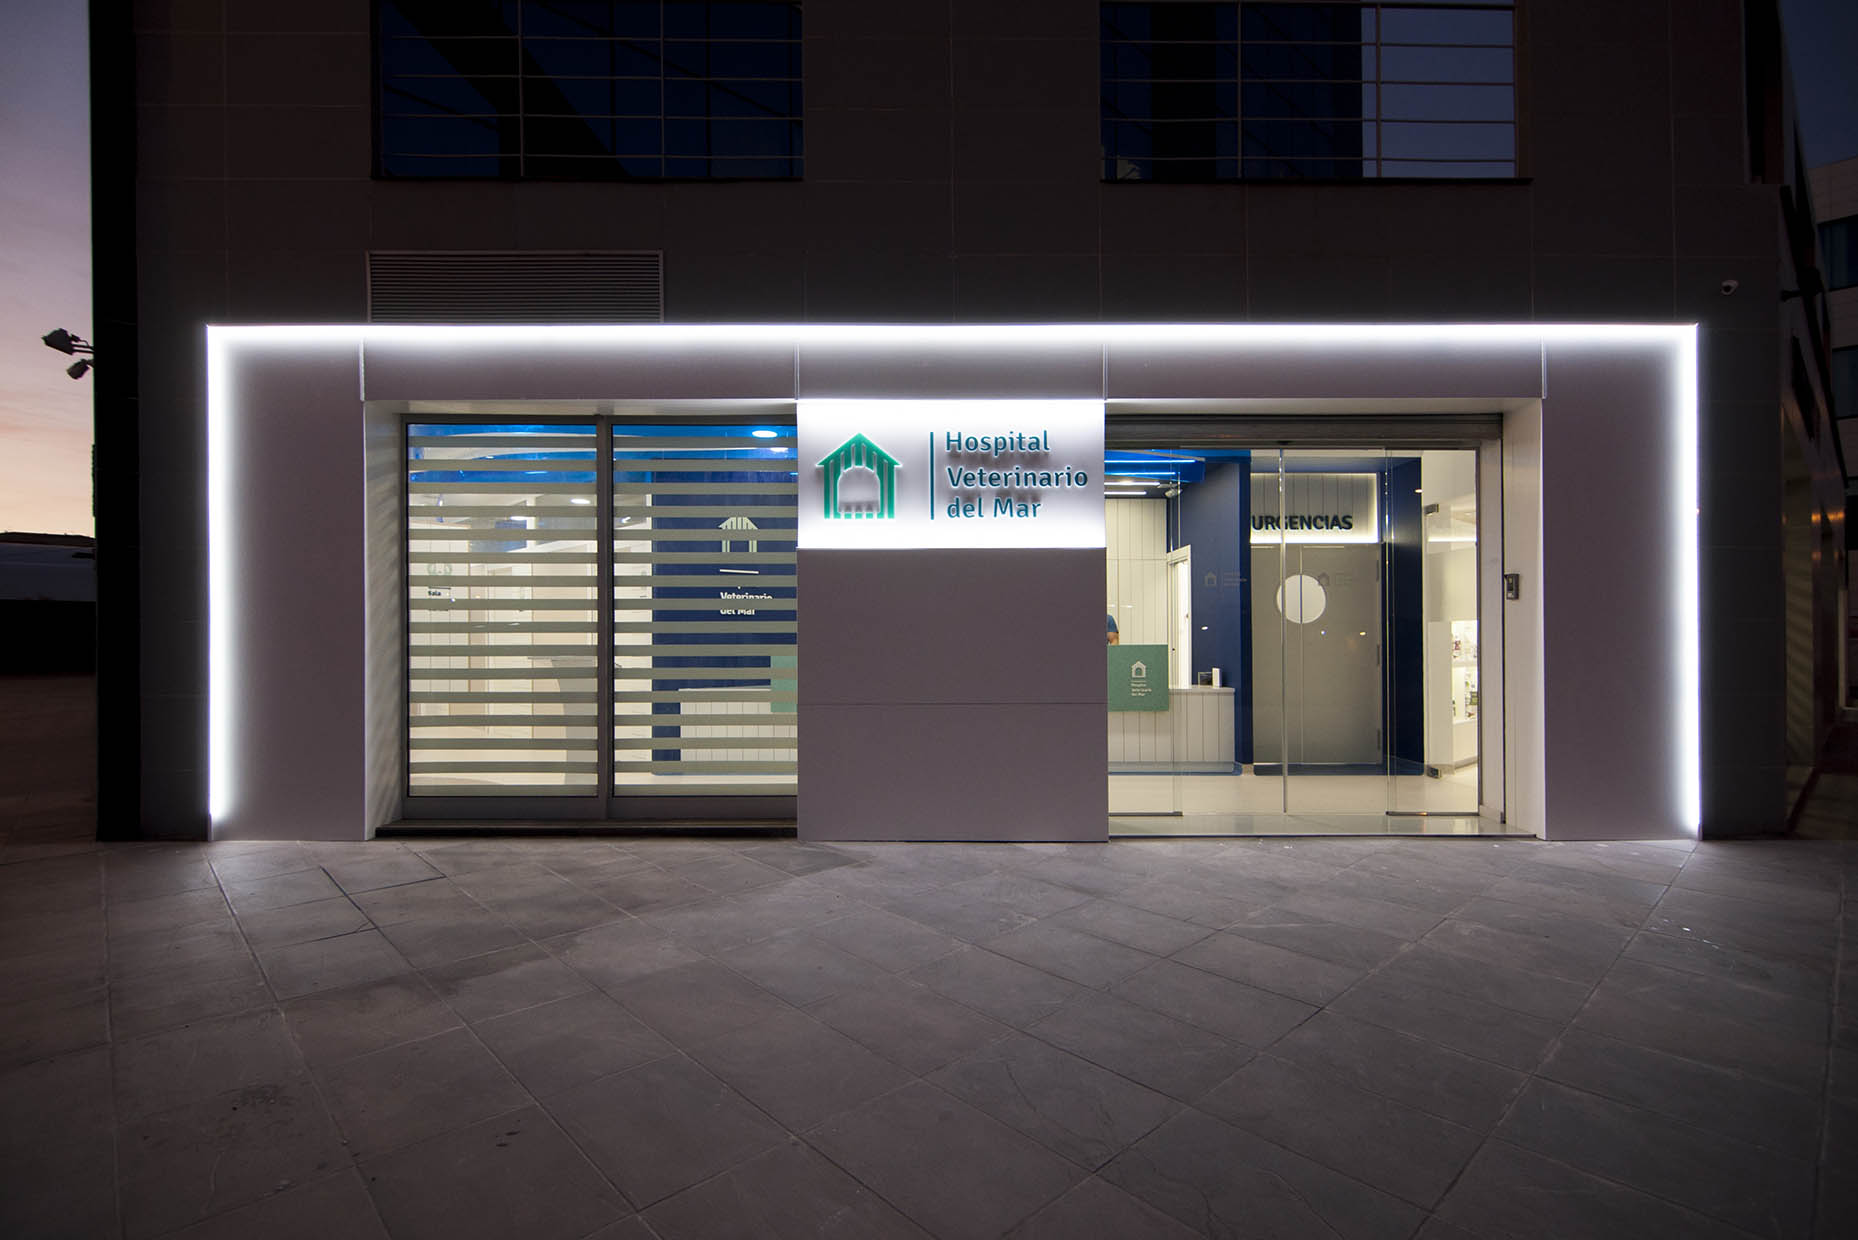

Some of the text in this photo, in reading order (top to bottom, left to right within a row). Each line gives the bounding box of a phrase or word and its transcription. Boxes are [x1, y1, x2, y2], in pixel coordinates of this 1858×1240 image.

[946, 430, 1050, 457] Hospital
[947, 466, 1088, 488] Veterinario
[947, 497, 1042, 518] del Mar
[1252, 514, 1353, 531] URGENCIAS
